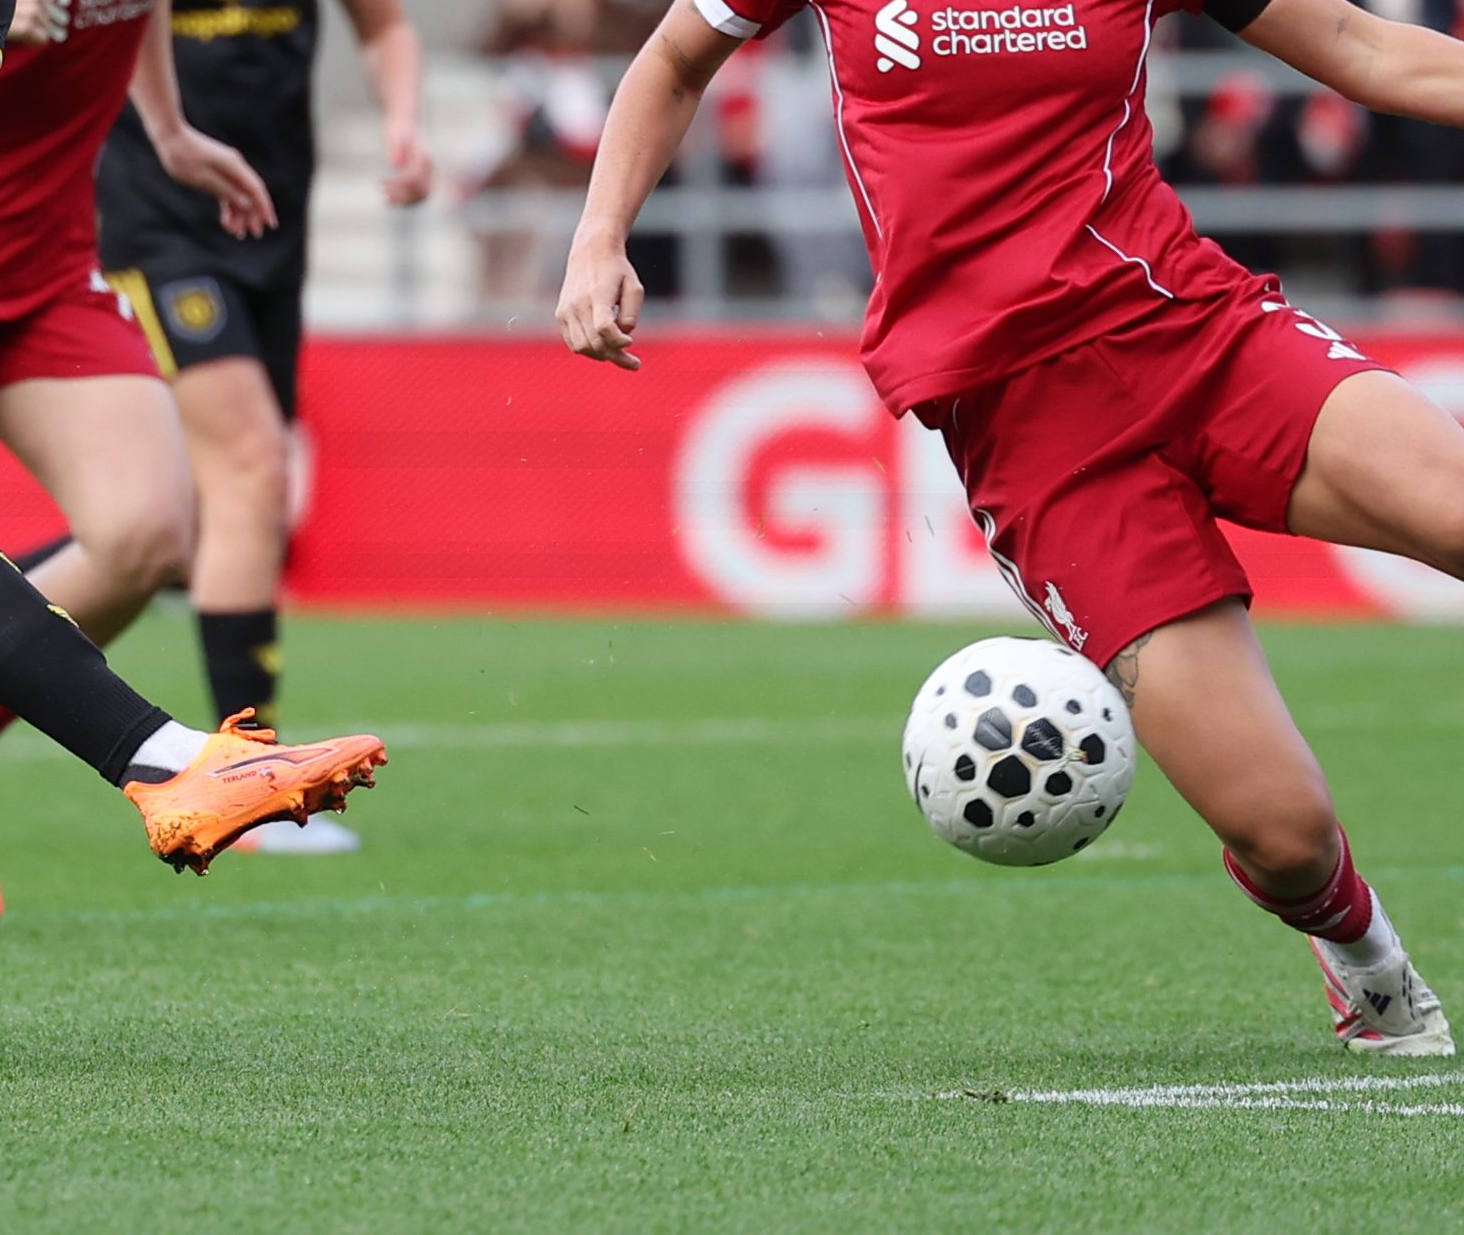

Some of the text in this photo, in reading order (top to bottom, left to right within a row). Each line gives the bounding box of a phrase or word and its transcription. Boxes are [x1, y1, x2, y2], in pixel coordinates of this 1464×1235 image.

[931, 3, 1075, 31] standard
[932, 25, 1087, 56] chartered
[222, 770, 258, 784] TERLAND
